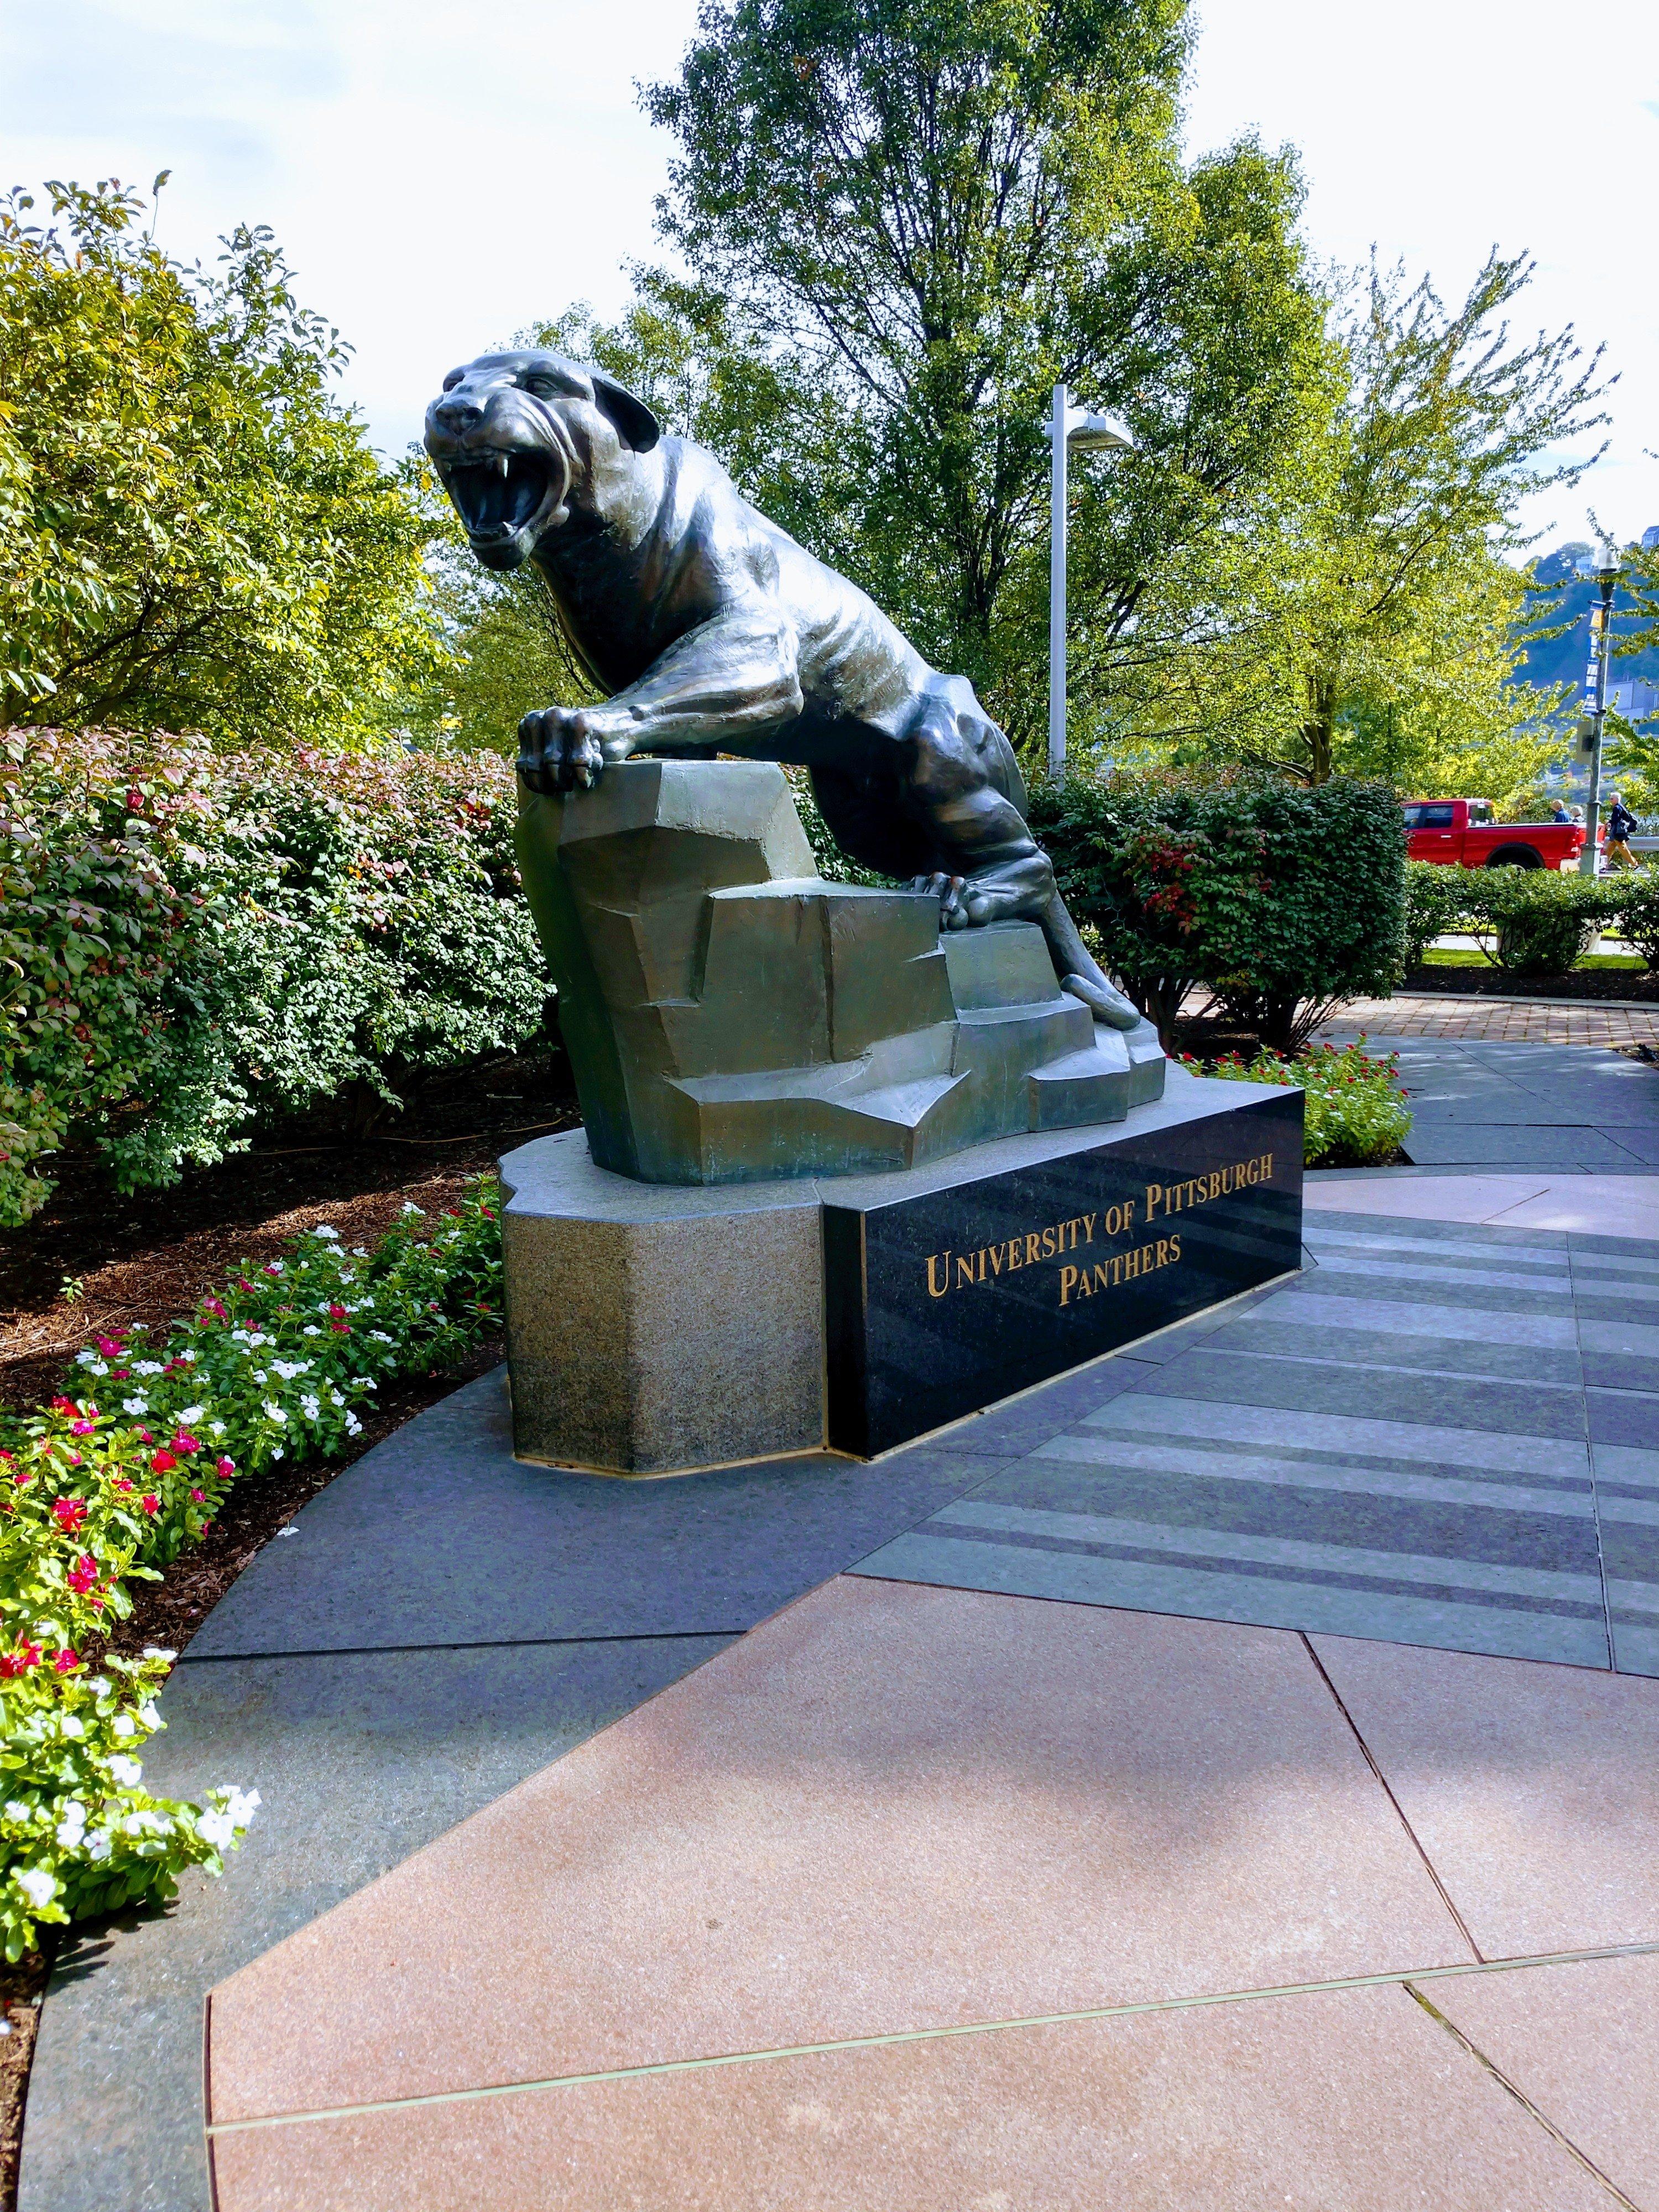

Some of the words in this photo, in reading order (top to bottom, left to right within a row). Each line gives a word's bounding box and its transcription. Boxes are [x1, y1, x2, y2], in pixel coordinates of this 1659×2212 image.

[925, 1213, 1097, 1297] UNIVERSITY
[1105, 1201, 1135, 1235] OF
[1145, 1153, 1273, 1222] PITTSBURGH
[1058, 1234, 1182, 1307] PANTHERS
